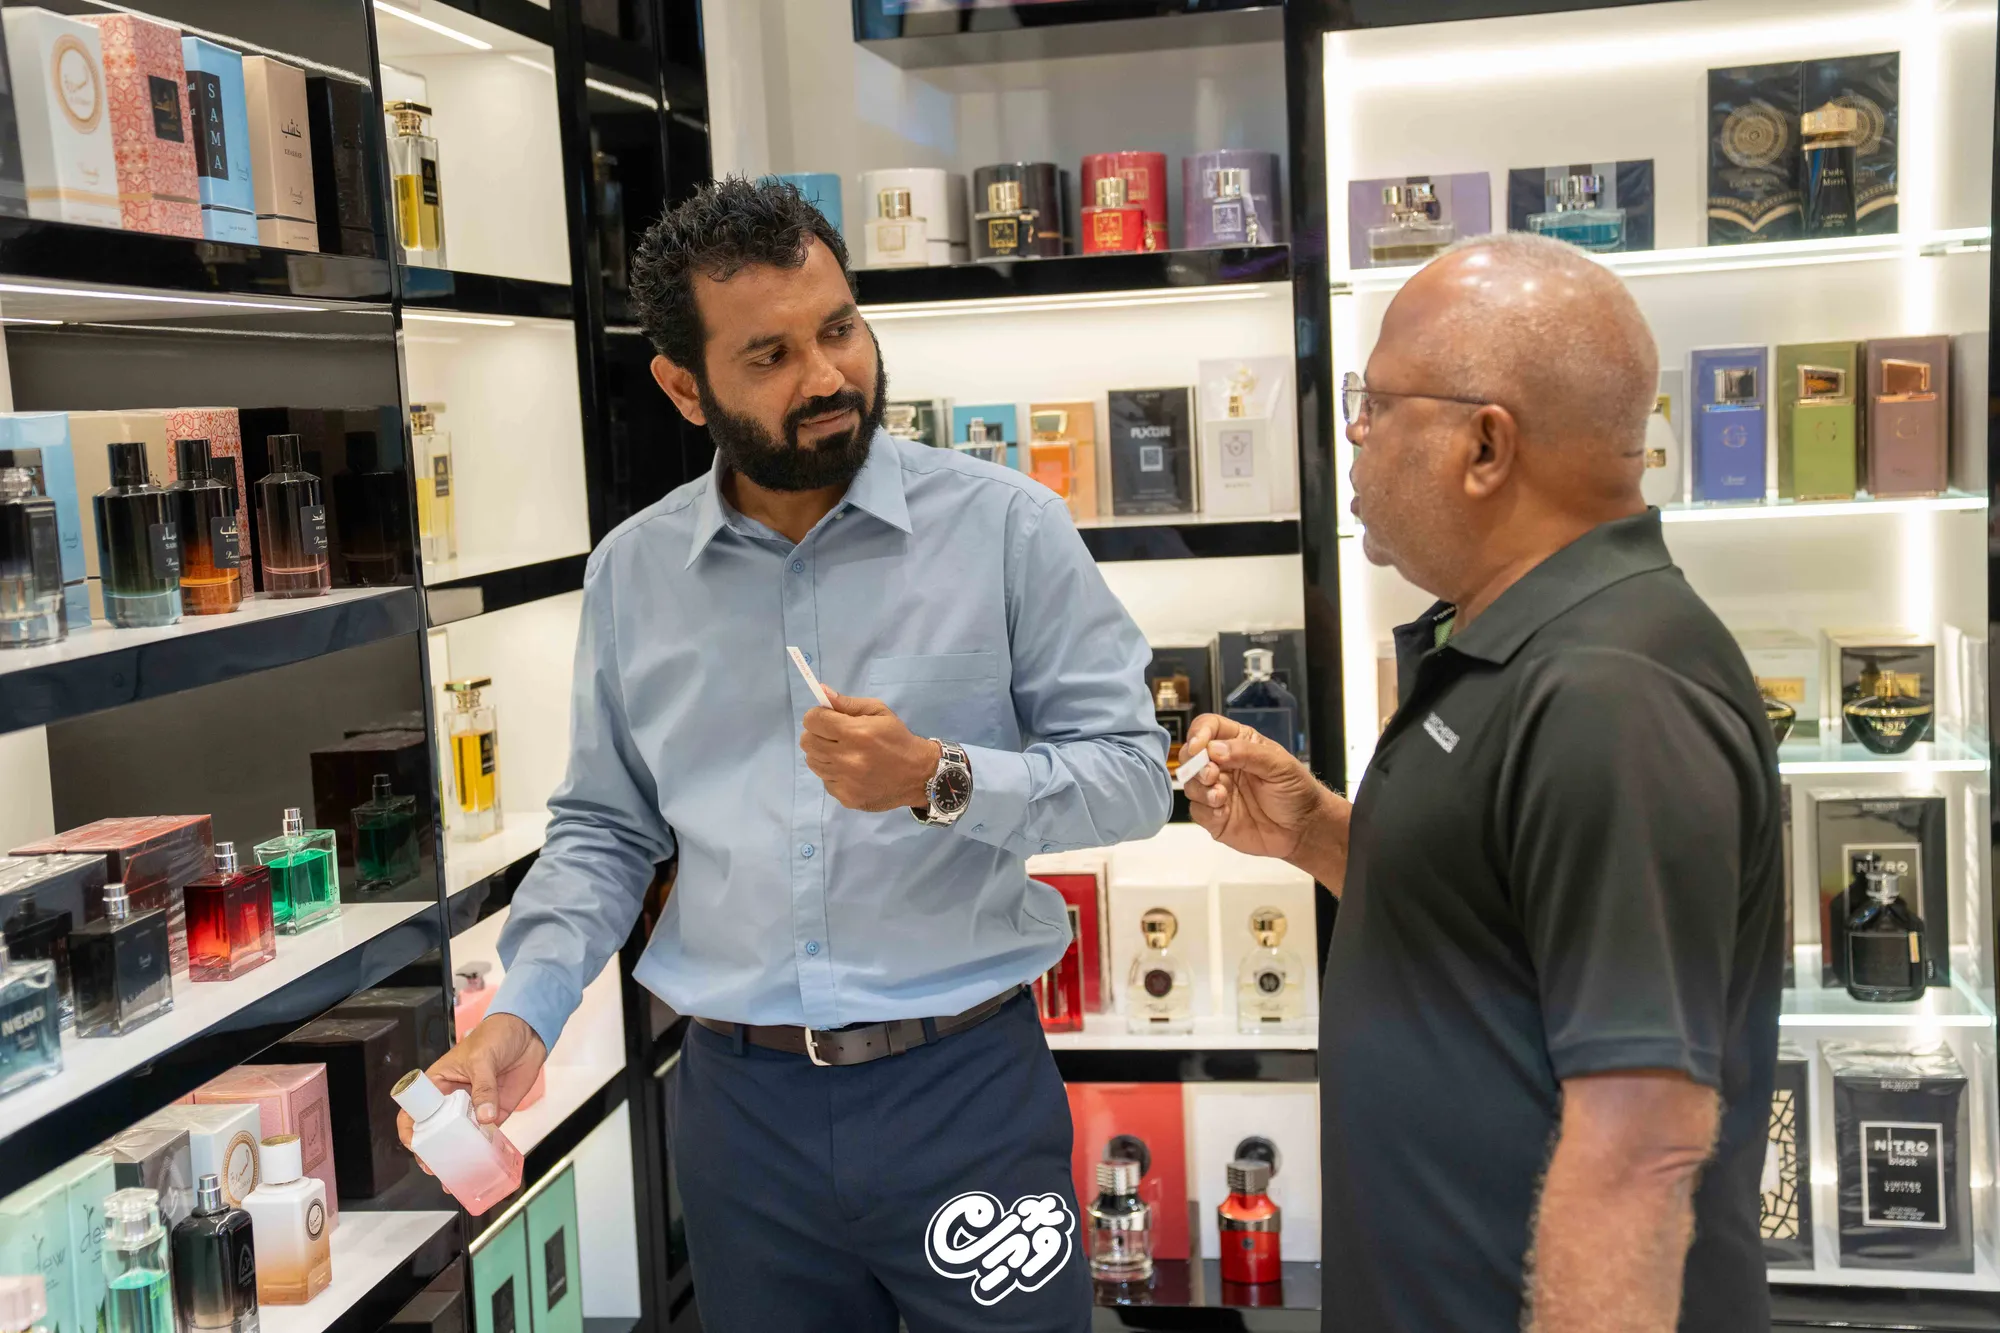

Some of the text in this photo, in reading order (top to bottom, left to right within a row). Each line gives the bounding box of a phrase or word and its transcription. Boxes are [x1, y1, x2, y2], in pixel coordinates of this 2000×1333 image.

[207, 83, 223, 170] SAMA
[1856, 860, 1908, 873] NITRO
[2, 1006, 46, 1037] NERO
[1874, 1139, 1930, 1152] NITRO
